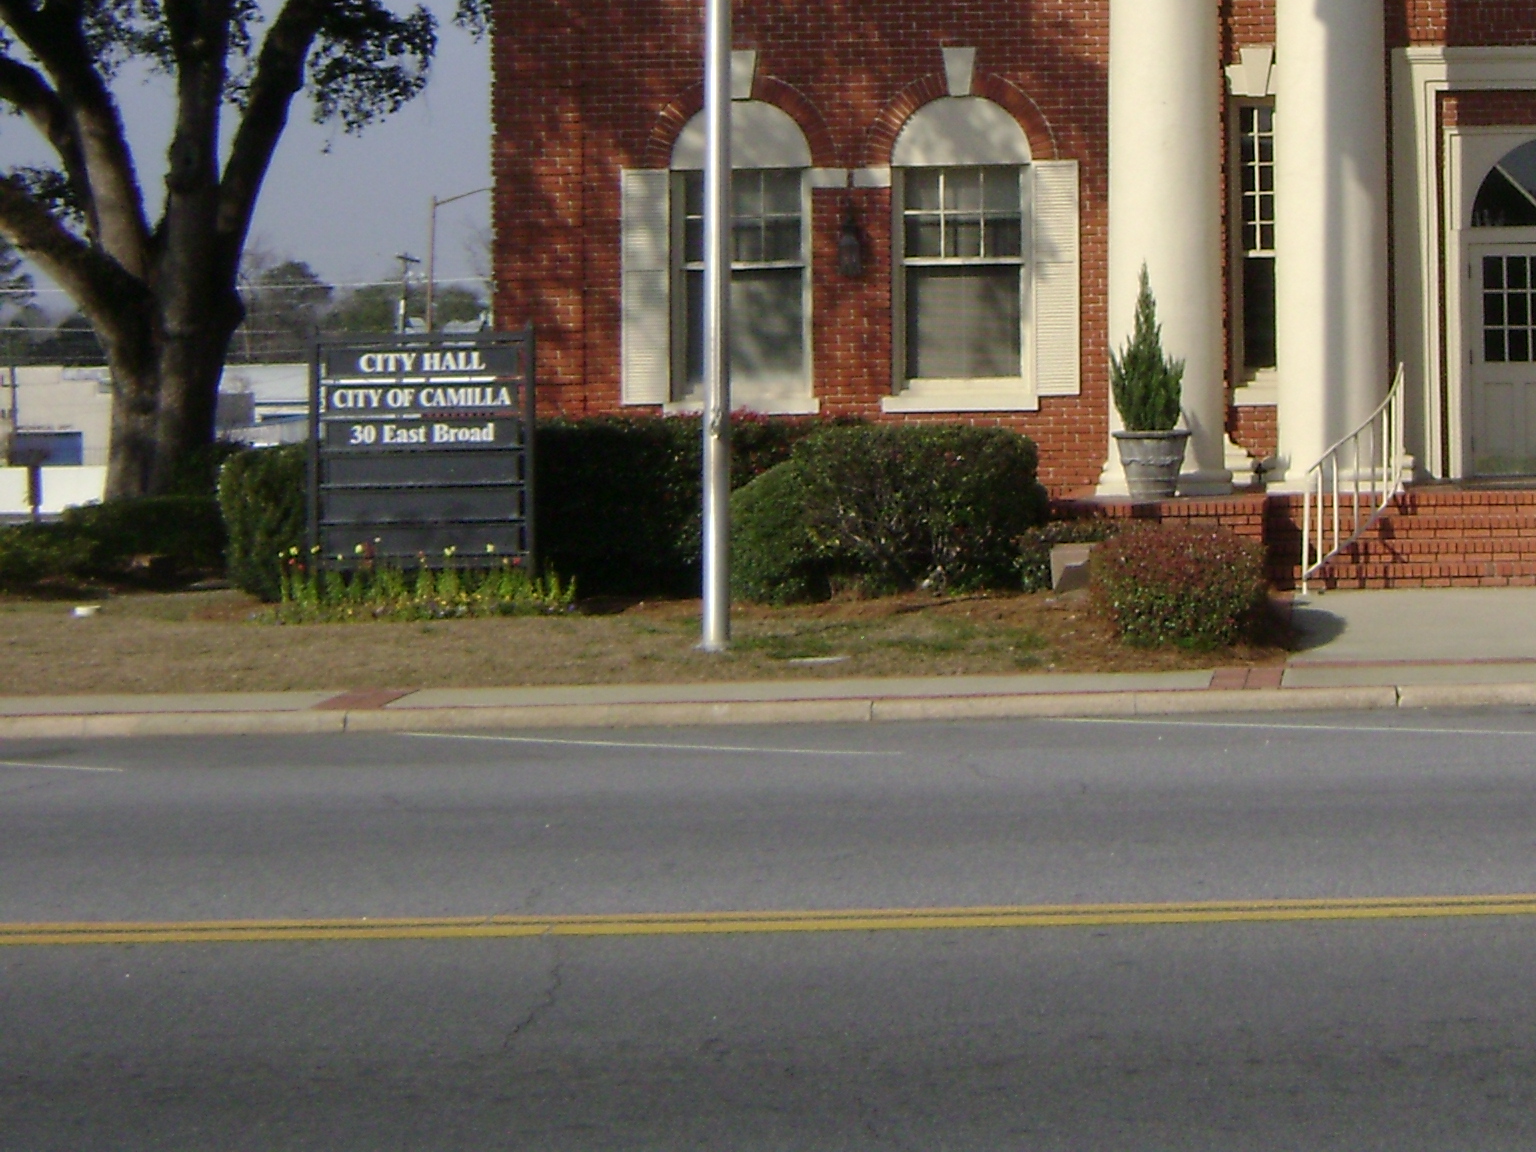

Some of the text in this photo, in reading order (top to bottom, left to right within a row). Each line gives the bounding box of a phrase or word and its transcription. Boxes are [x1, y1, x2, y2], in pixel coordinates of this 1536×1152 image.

[358, 351, 486, 373] CITY HALL
[332, 387, 511, 408] CITY OF CAMILLA
[350, 422, 495, 444] 30 East Broad
